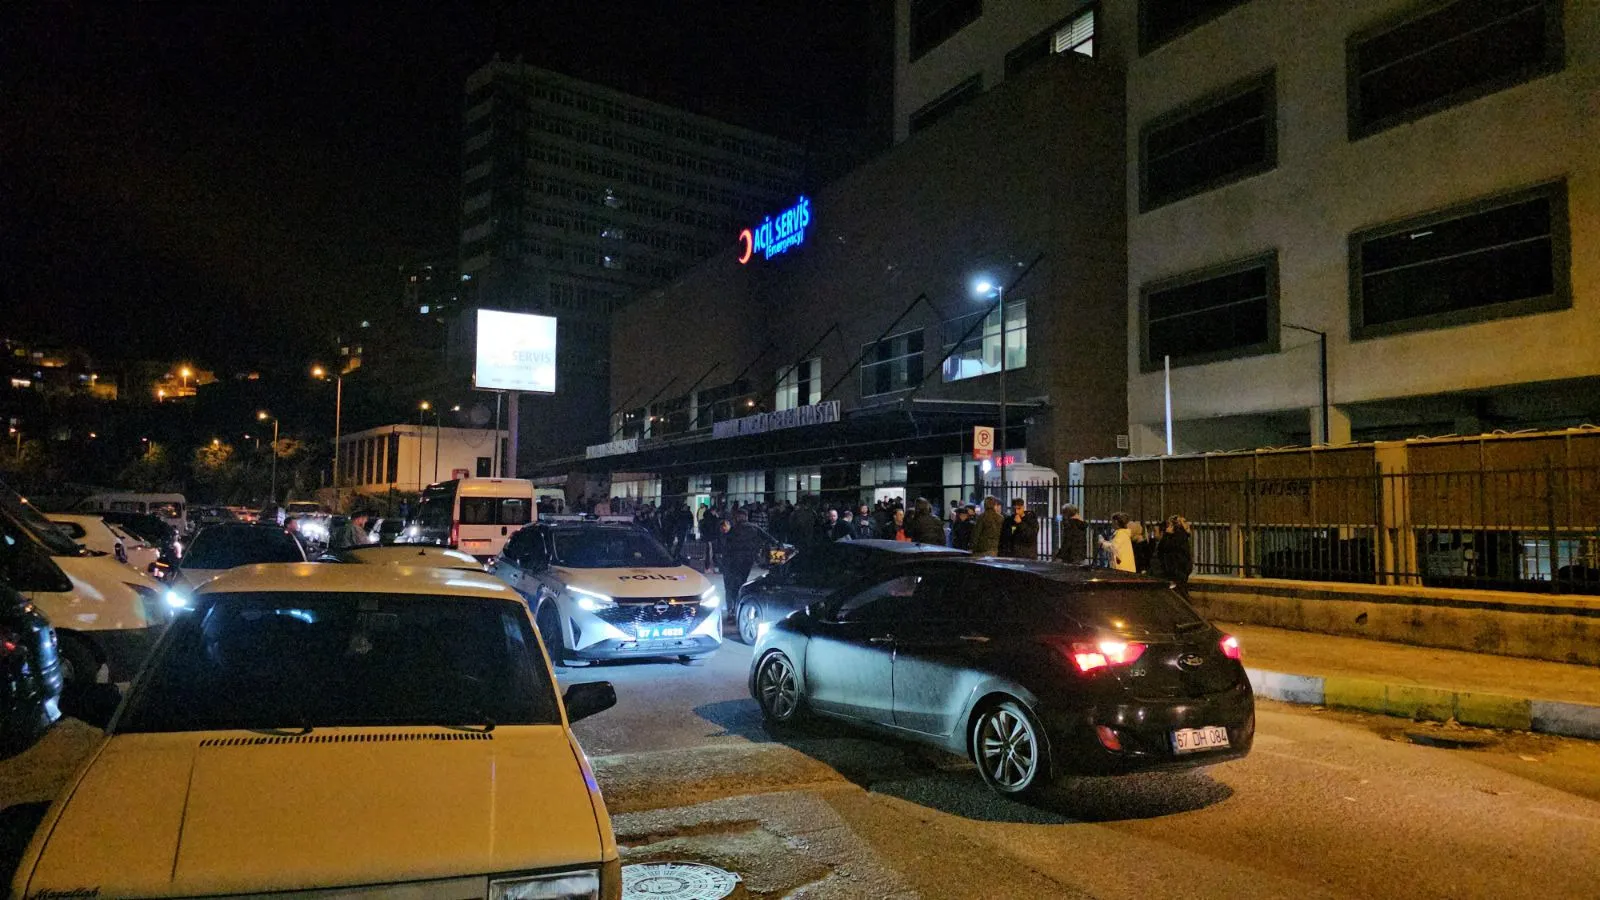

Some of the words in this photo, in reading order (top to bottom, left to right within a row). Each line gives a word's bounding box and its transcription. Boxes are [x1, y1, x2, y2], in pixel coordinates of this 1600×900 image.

[753, 216, 774, 253] ACİL
[775, 196, 809, 241] SERVİS
[1177, 732, 1188, 748] 67
[1192, 730, 1208, 746] DH
[1209, 729, 1227, 744] 084
